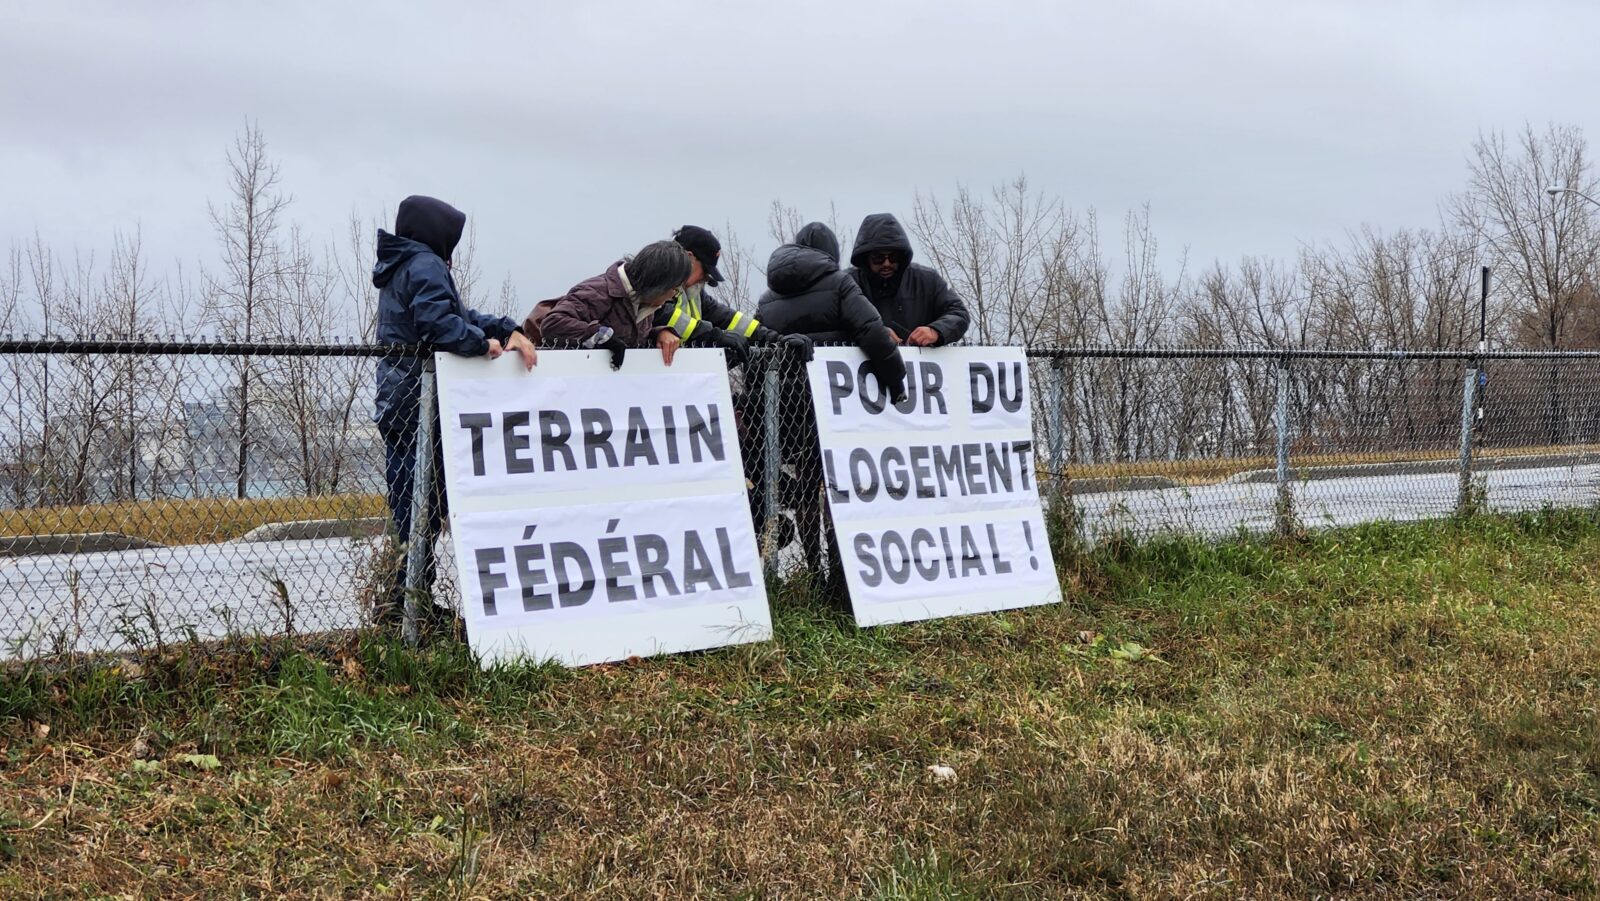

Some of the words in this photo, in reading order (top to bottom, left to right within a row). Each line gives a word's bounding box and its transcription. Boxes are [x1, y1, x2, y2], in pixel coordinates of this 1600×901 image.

[826, 360, 948, 415] POUR
[969, 361, 1023, 414] DU
[459, 403, 726, 476] TERRAIN
[823, 440, 1032, 504] LOGEMENT
[474, 518, 753, 616] FÉDÉRAL
[853, 523, 1012, 588] SOCIAL
[1022, 520, 1039, 572] !
